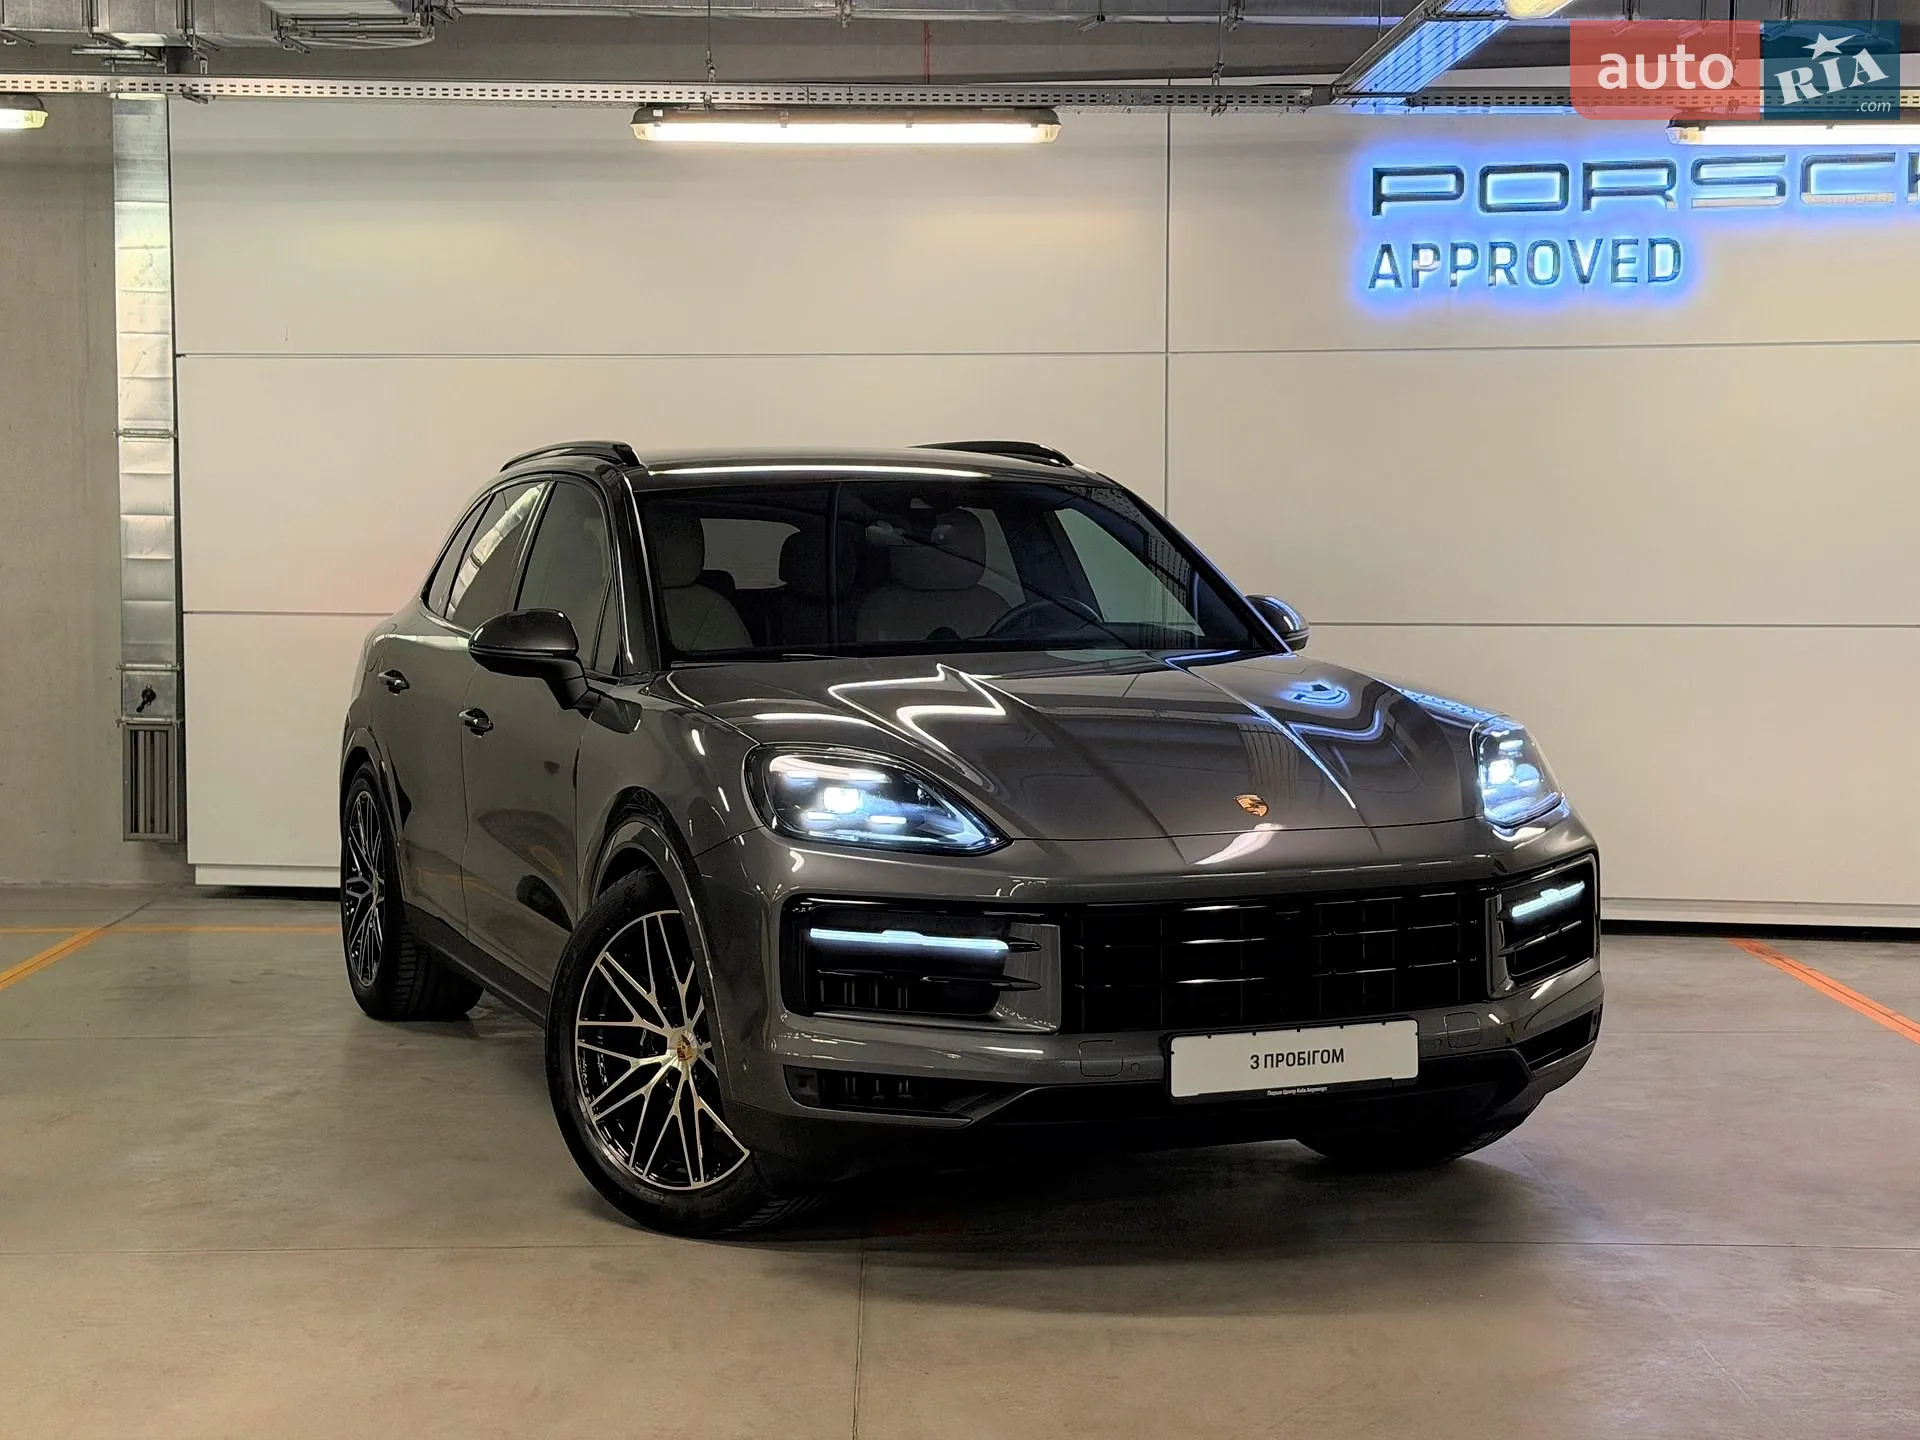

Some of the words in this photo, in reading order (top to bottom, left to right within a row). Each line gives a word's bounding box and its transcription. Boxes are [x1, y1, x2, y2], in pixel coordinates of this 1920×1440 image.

[1371, 151, 1920, 217] PORSC
[1367, 237, 1682, 289] APPROVED
[1250, 1054, 1260, 1070] З
[1263, 1047, 1345, 1069] ПРОБІГОМ
